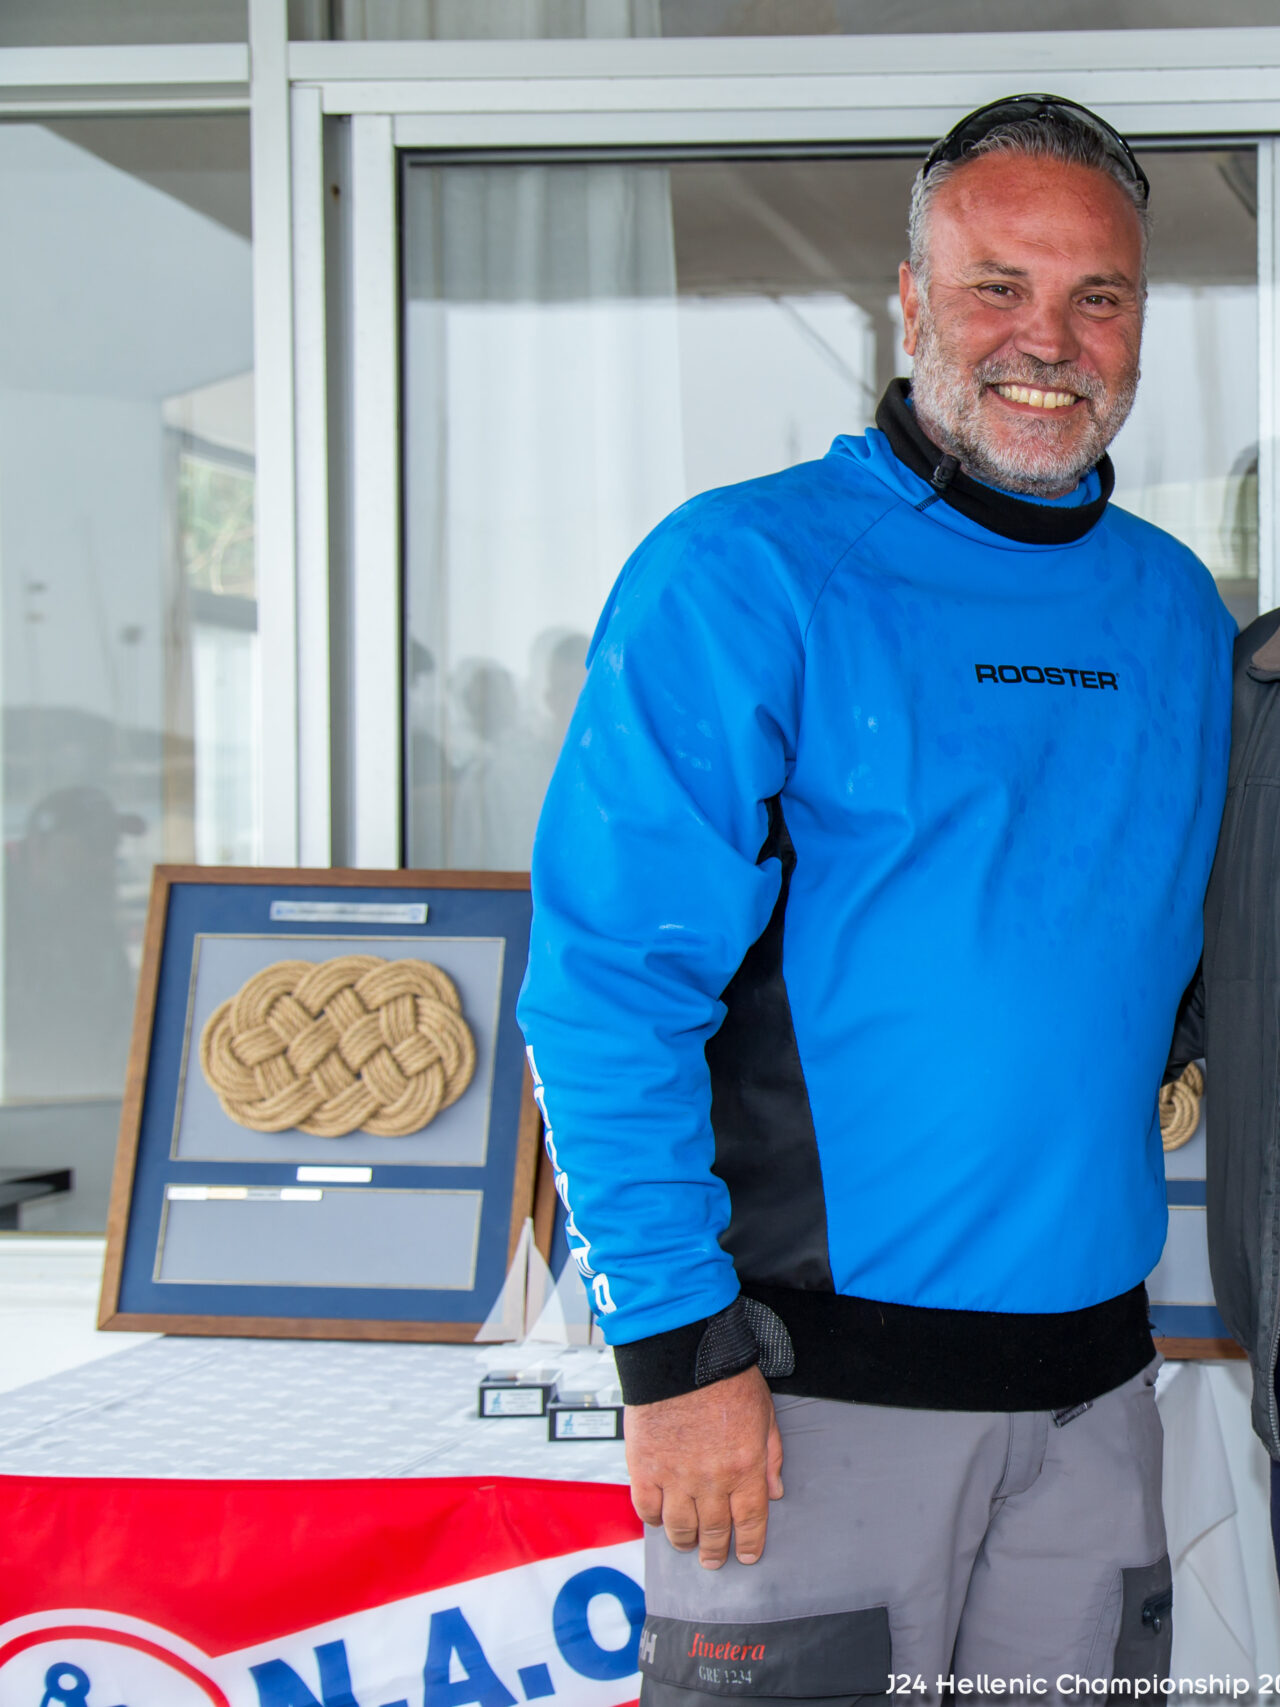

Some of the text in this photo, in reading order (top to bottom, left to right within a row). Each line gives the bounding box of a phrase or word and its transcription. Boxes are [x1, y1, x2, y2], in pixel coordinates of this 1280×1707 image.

[974, 663, 1119, 691] ROOSTER
[687, 1632, 767, 1662] Jinetera
[698, 1665, 721, 1683] GRE
